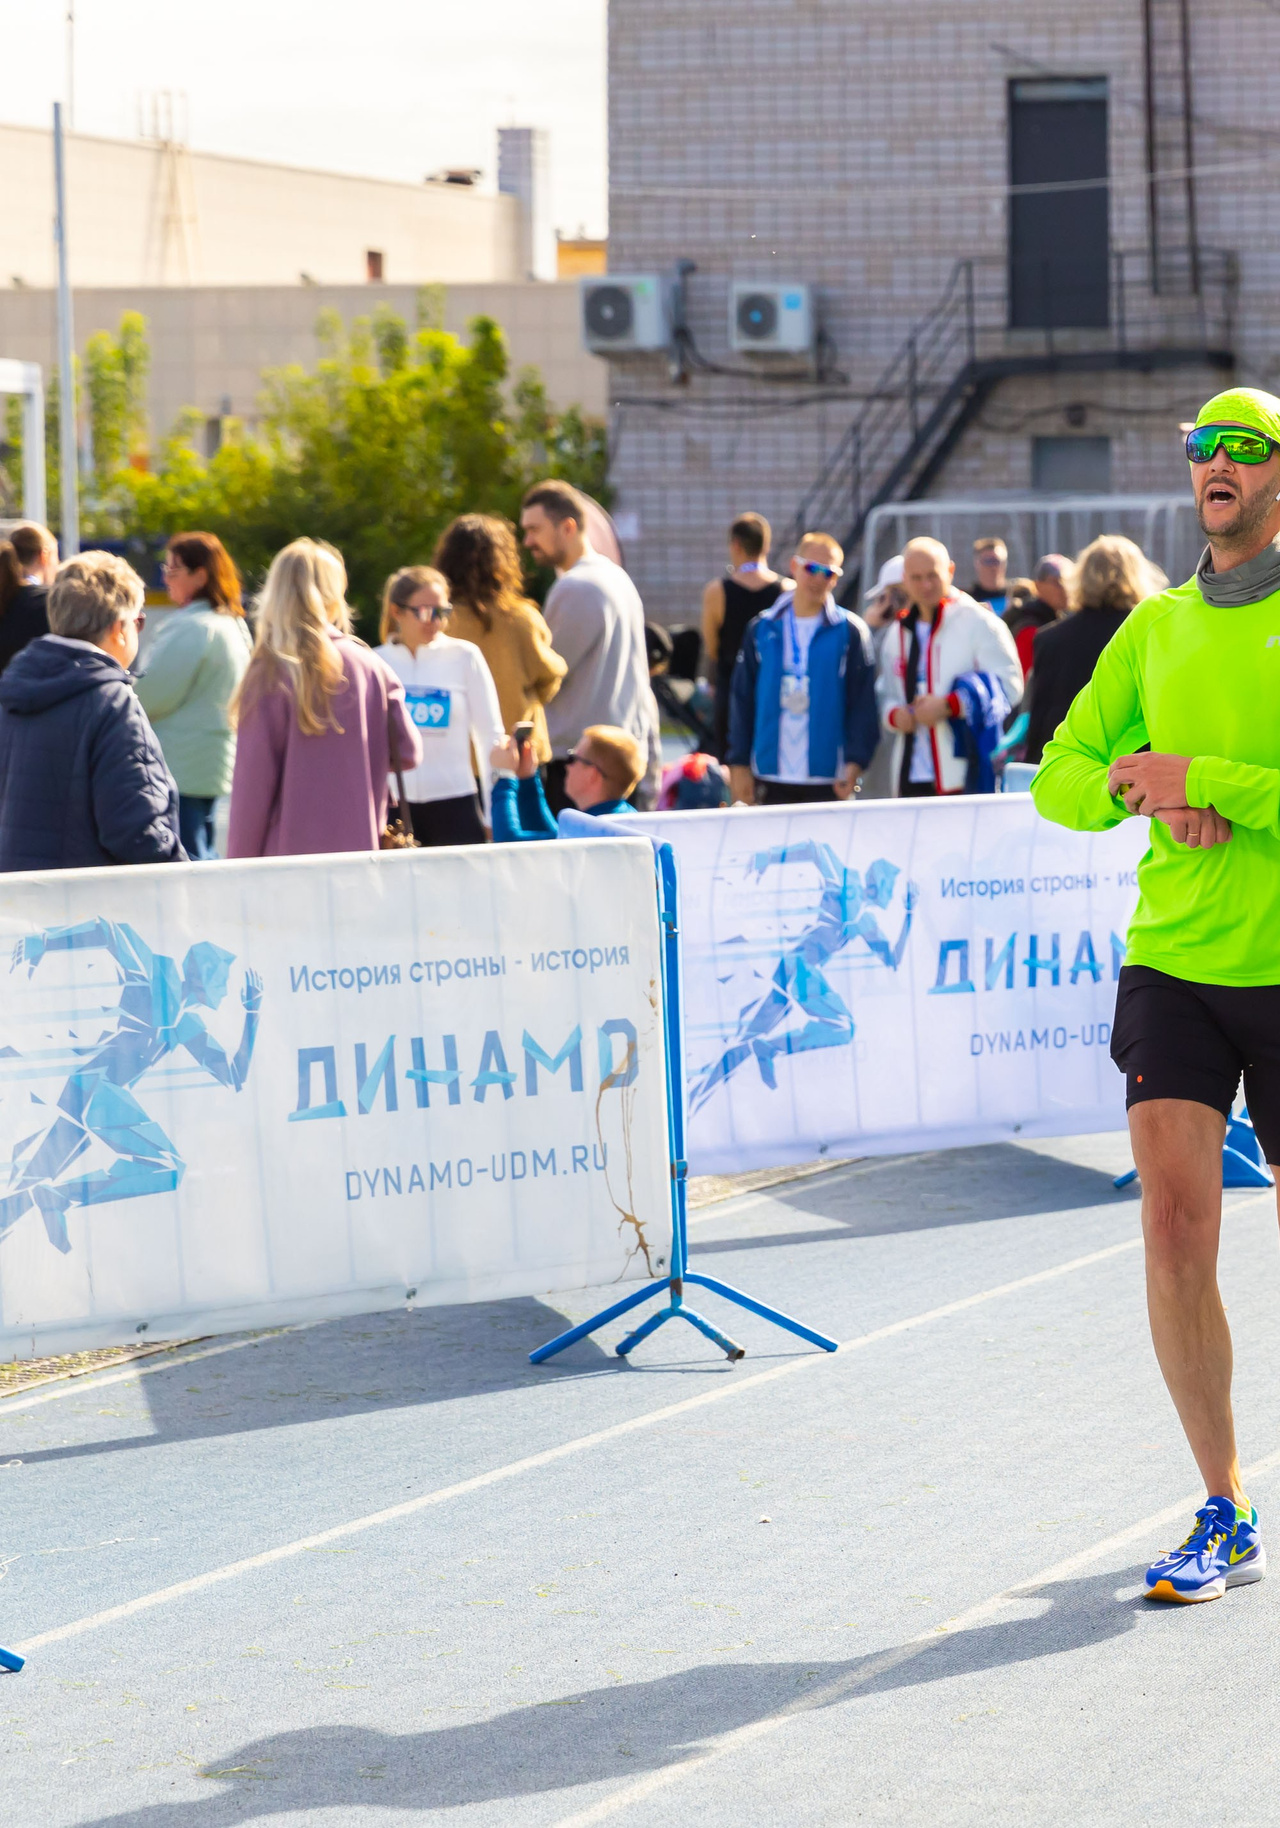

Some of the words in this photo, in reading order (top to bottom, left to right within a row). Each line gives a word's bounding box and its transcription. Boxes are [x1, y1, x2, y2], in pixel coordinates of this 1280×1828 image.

[940, 878, 1025, 899] История
[1030, 873, 1098, 895] страны
[289, 964, 402, 994] История
[409, 955, 507, 987] страны
[531, 945, 630, 974] история
[287, 1018, 640, 1122] ДИНАМО
[345, 1142, 608, 1201] DYNAMO-UDM.RU
